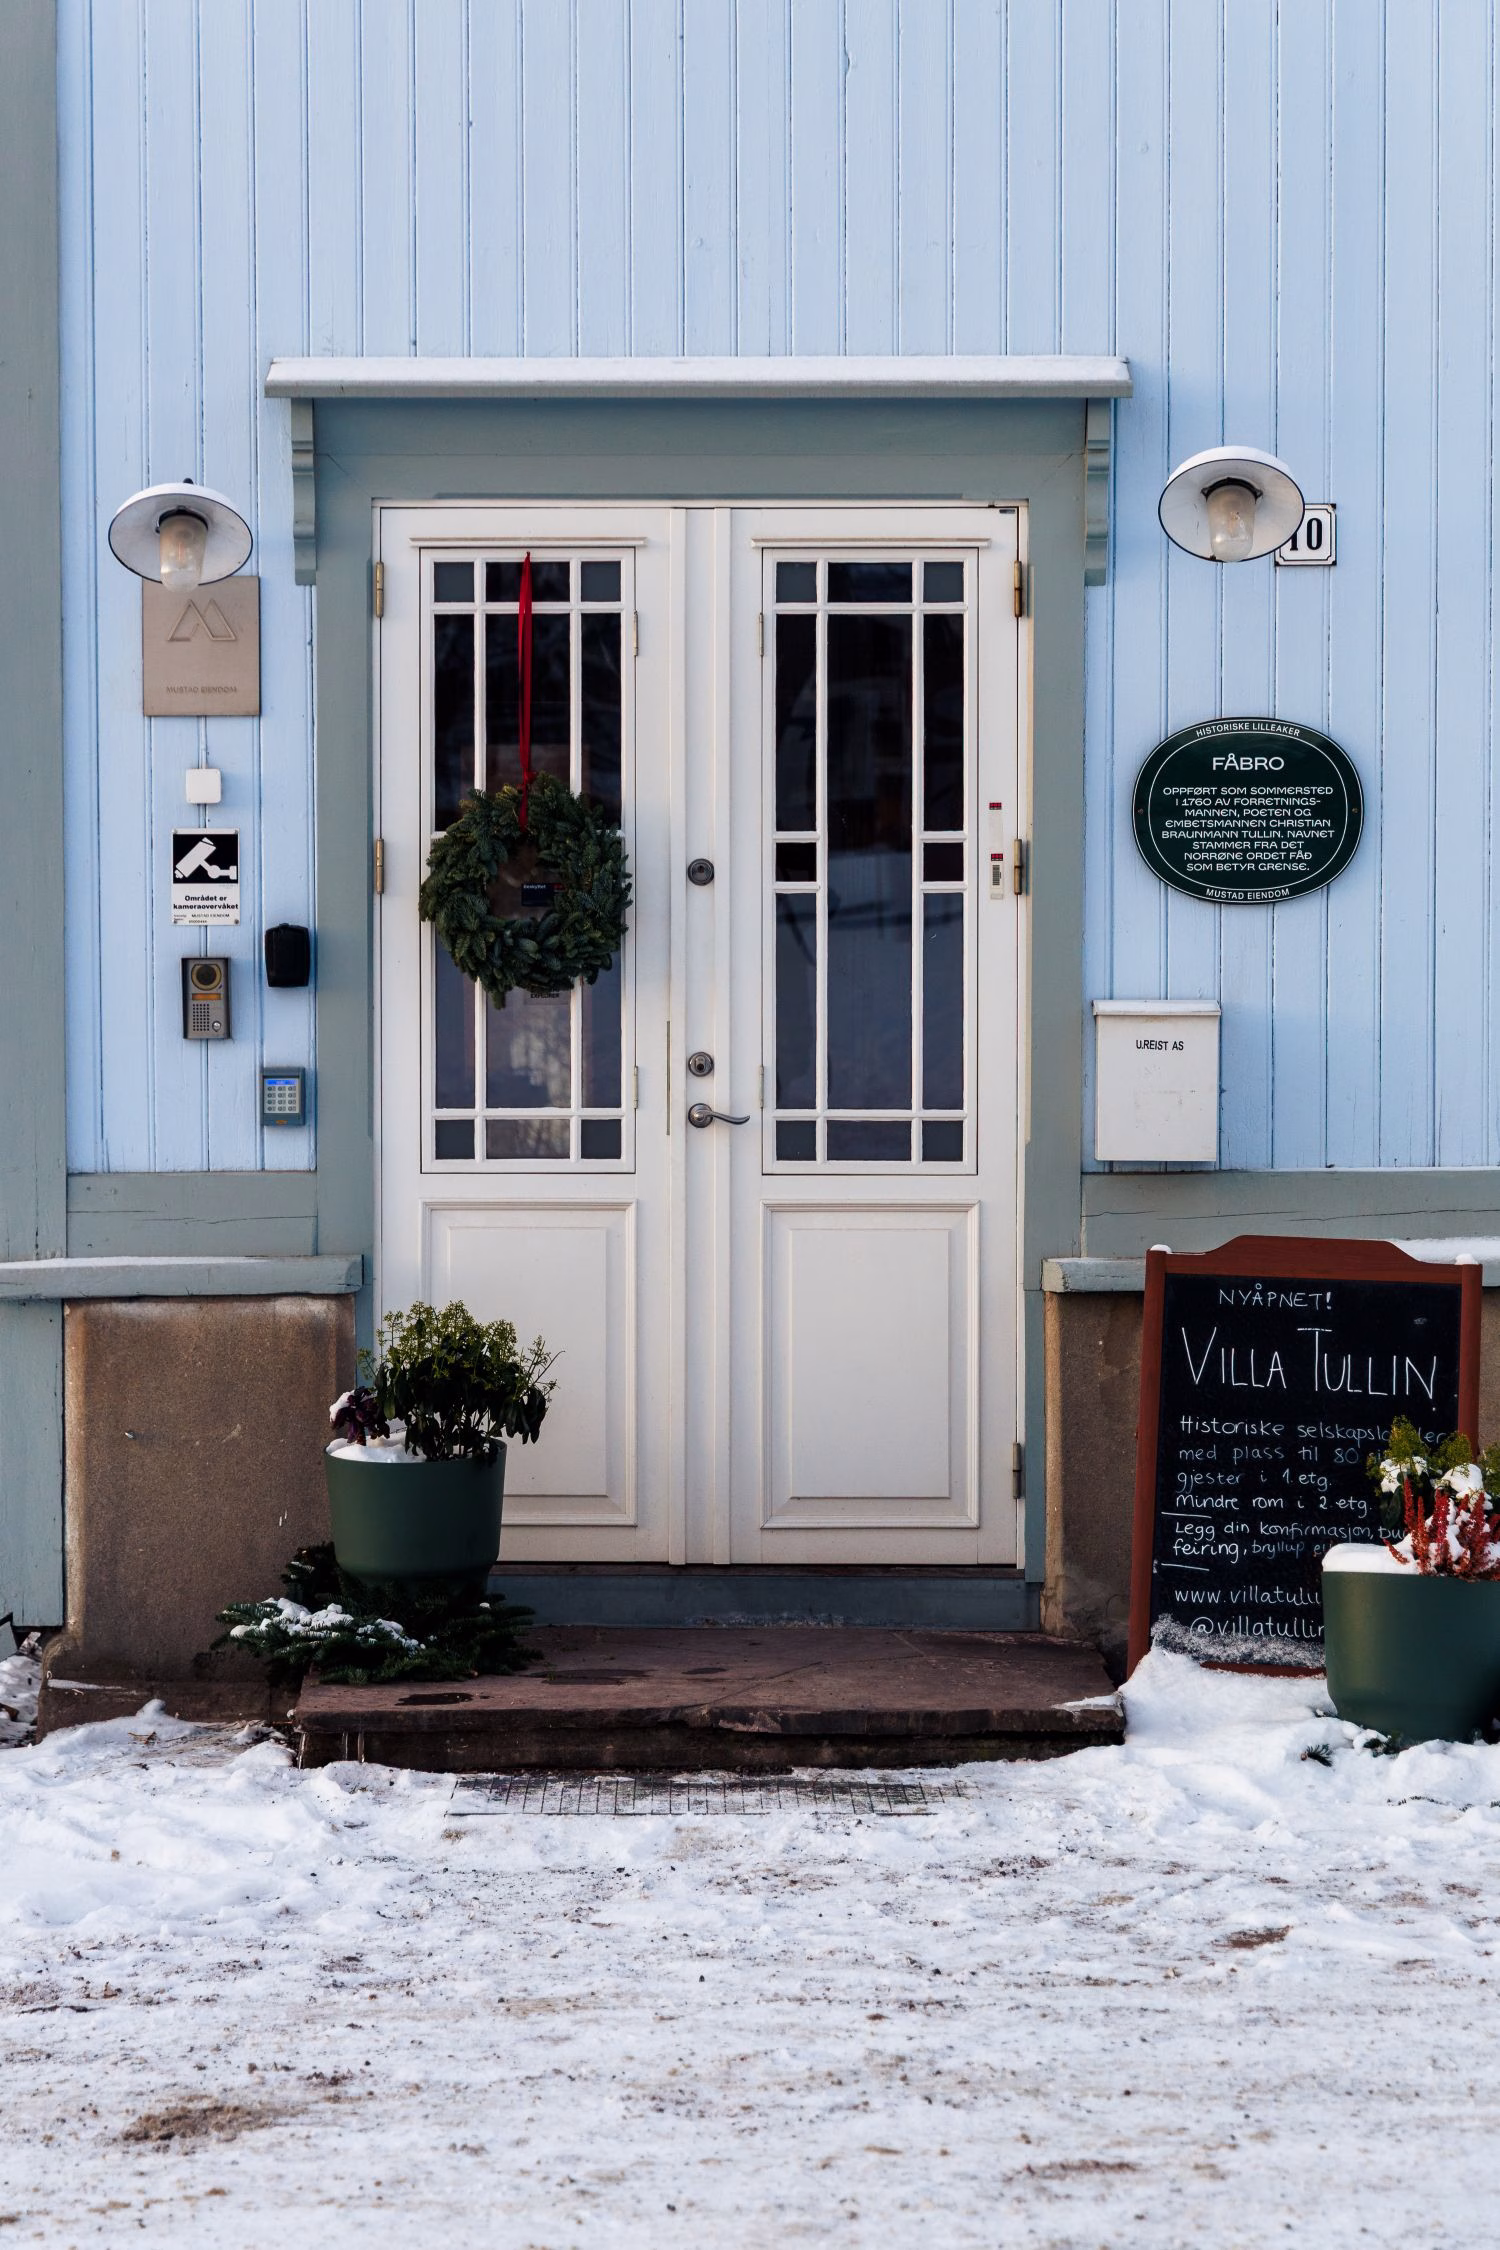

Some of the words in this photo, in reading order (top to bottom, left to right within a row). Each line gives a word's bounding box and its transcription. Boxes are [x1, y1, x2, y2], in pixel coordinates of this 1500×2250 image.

[166, 686, 199, 694] MUSTAD
[200, 686, 237, 694] EIENDOM
[1196, 722, 1250, 738] HISTORISKE
[1252, 722, 1301, 737] LILLEAKER
[1212, 753, 1284, 771] FÅBRO
[1163, 786, 1217, 796] OPPFØRT
[1221, 786, 1247, 796] SOM
[1250, 786, 1333, 796] SOMMERSTED
[1181, 797, 1211, 806] 1760
[1215, 797, 1231, 806] AV
[1234, 797, 1321, 806] FORRETNINGS-
[1185, 808, 1240, 818] MANNEN,
[1243, 808, 1291, 817] POETEN
[1294, 808, 1312, 817] OG
[1165, 819, 1266, 828] EMBETSMANNEN
[1269, 819, 1331, 828] CHRISTIAN
[1161, 830, 1239, 839] BRAUNMANN
[1241, 830, 1284, 839] TULLIN.
[1287, 830, 1335, 839] NAVNET
[1192, 841, 1251, 850] STAMMER
[1254, 841, 1278, 850] FRA
[1281, 841, 1304, 850] DET
[1184, 852, 1243, 860] NORRØNE
[1246, 852, 1286, 860] ORDET
[1186, 863, 1213, 871] SOM
[1216, 863, 1255, 871] BETYR
[1258, 863, 1310, 871] GRENSE.
[184, 894, 217, 902] Området
[1206, 888, 1244, 900] MUSTAD
[1247, 888, 1290, 900] EIENDOM
[1136, 1039, 1169, 1051] U.REIST
[1171, 1040, 1184, 1051] AS
[1219, 1283, 1332, 1310] NYÅPNET!
[1181, 1326, 1287, 1389] VILLA
[1297, 1327, 1437, 1400] TULLIN
[1180, 1415, 1284, 1436] Historiske
[1297, 1421, 1447, 1449] selskapsloler
[1179, 1444, 1217, 1460] med
[1233, 1445, 1284, 1465] plass
[1297, 1445, 1318, 1461] til
[1334, 1447, 1359, 1464] 80
[1176, 1469, 1244, 1494] gjester
[1260, 1470, 1267, 1482] i
[1176, 1494, 1239, 1510] Mindre
[1252, 1497, 1284, 1509] rom
[1297, 1496, 1305, 1508] i
[1175, 1521, 1215, 1541] Legg
[1223, 1521, 1250, 1534] din
[1260, 1521, 1374, 1543] konfirmasjon,
[1173, 1538, 1247, 1563] feiring,
[1252, 1539, 1304, 1559] bryllup
